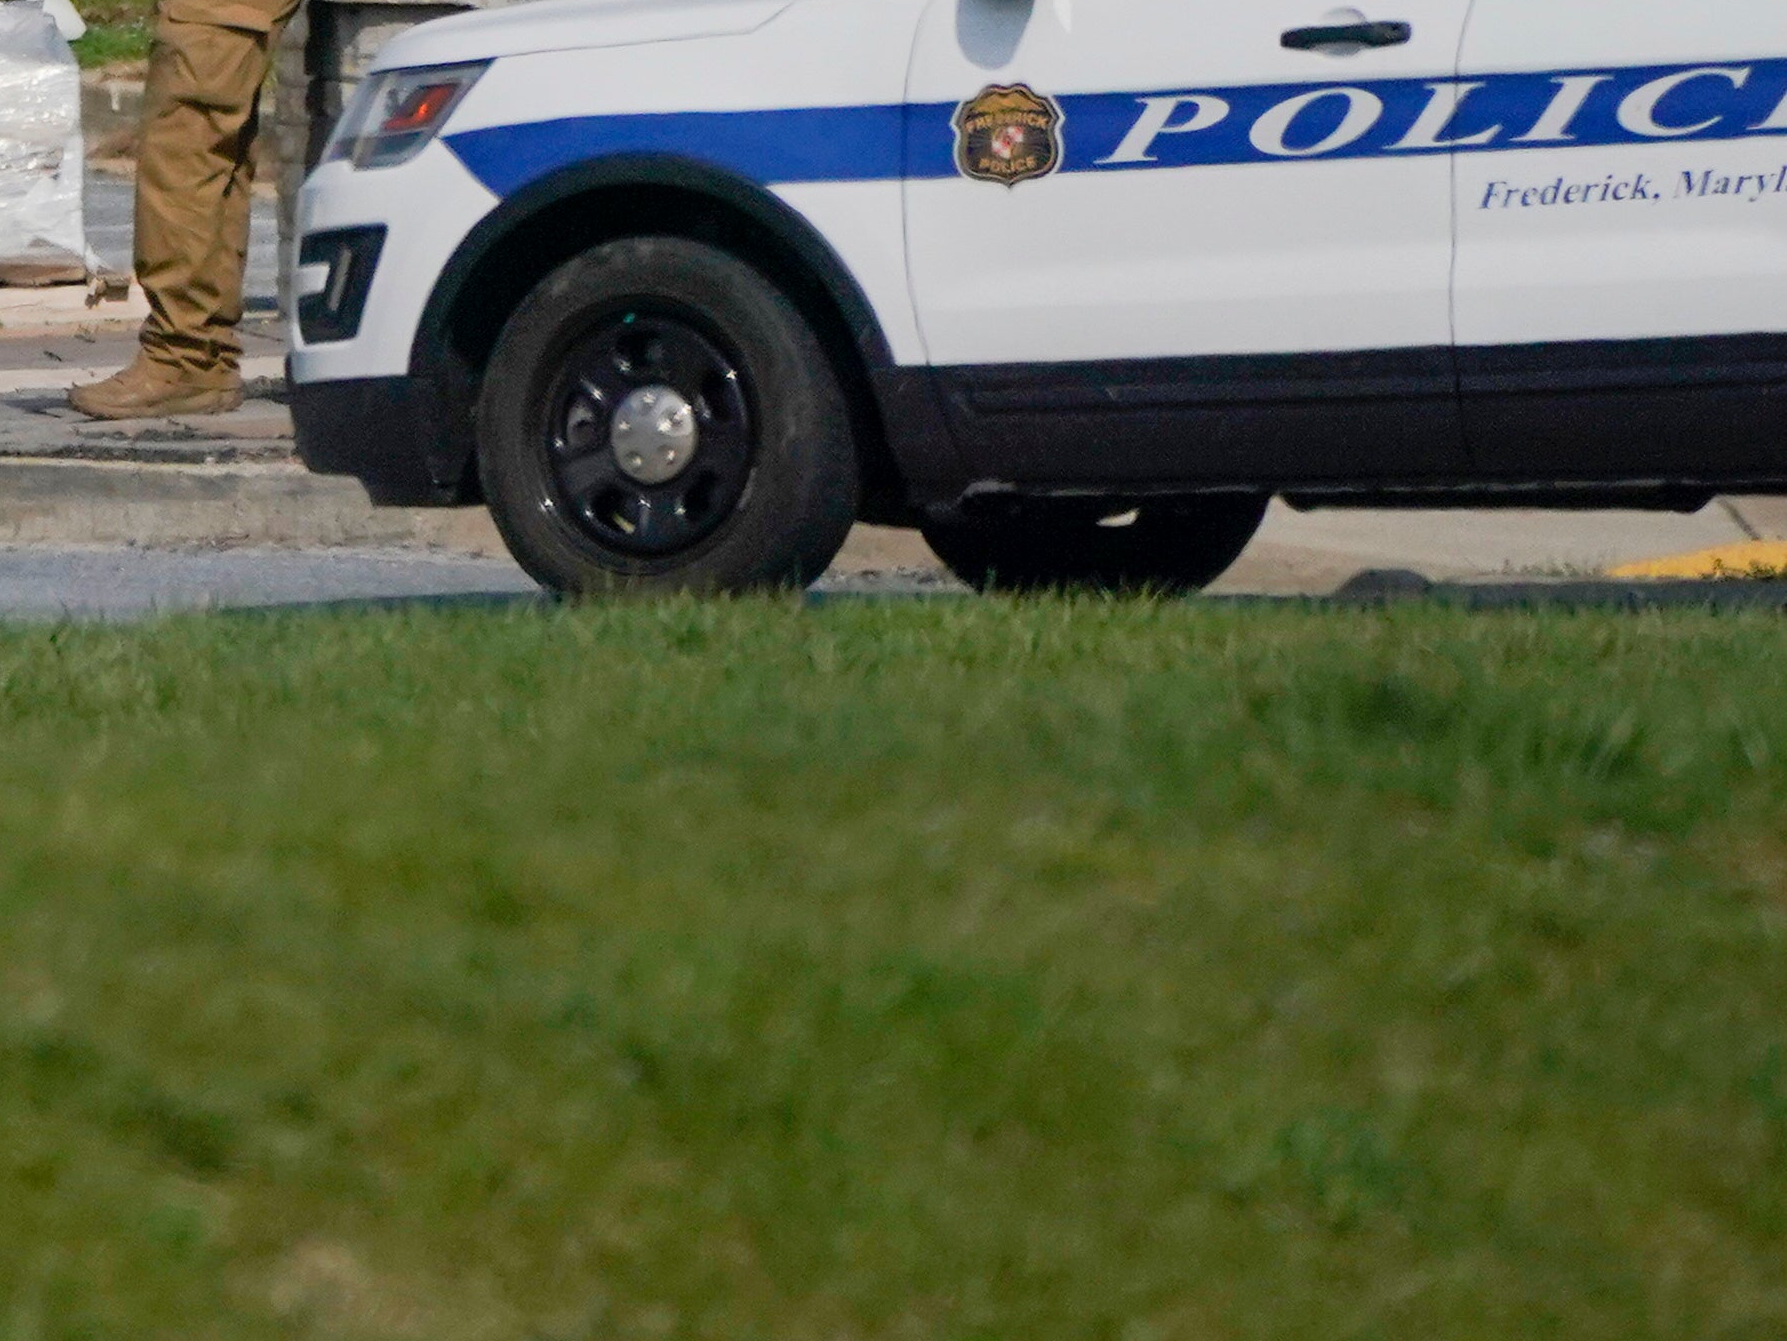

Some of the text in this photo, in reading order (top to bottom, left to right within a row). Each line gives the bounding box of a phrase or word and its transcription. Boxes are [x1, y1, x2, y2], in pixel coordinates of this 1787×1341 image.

[978, 156, 1037, 174] POLICE
[1477, 164, 1787, 210] Frederick, Maryl
